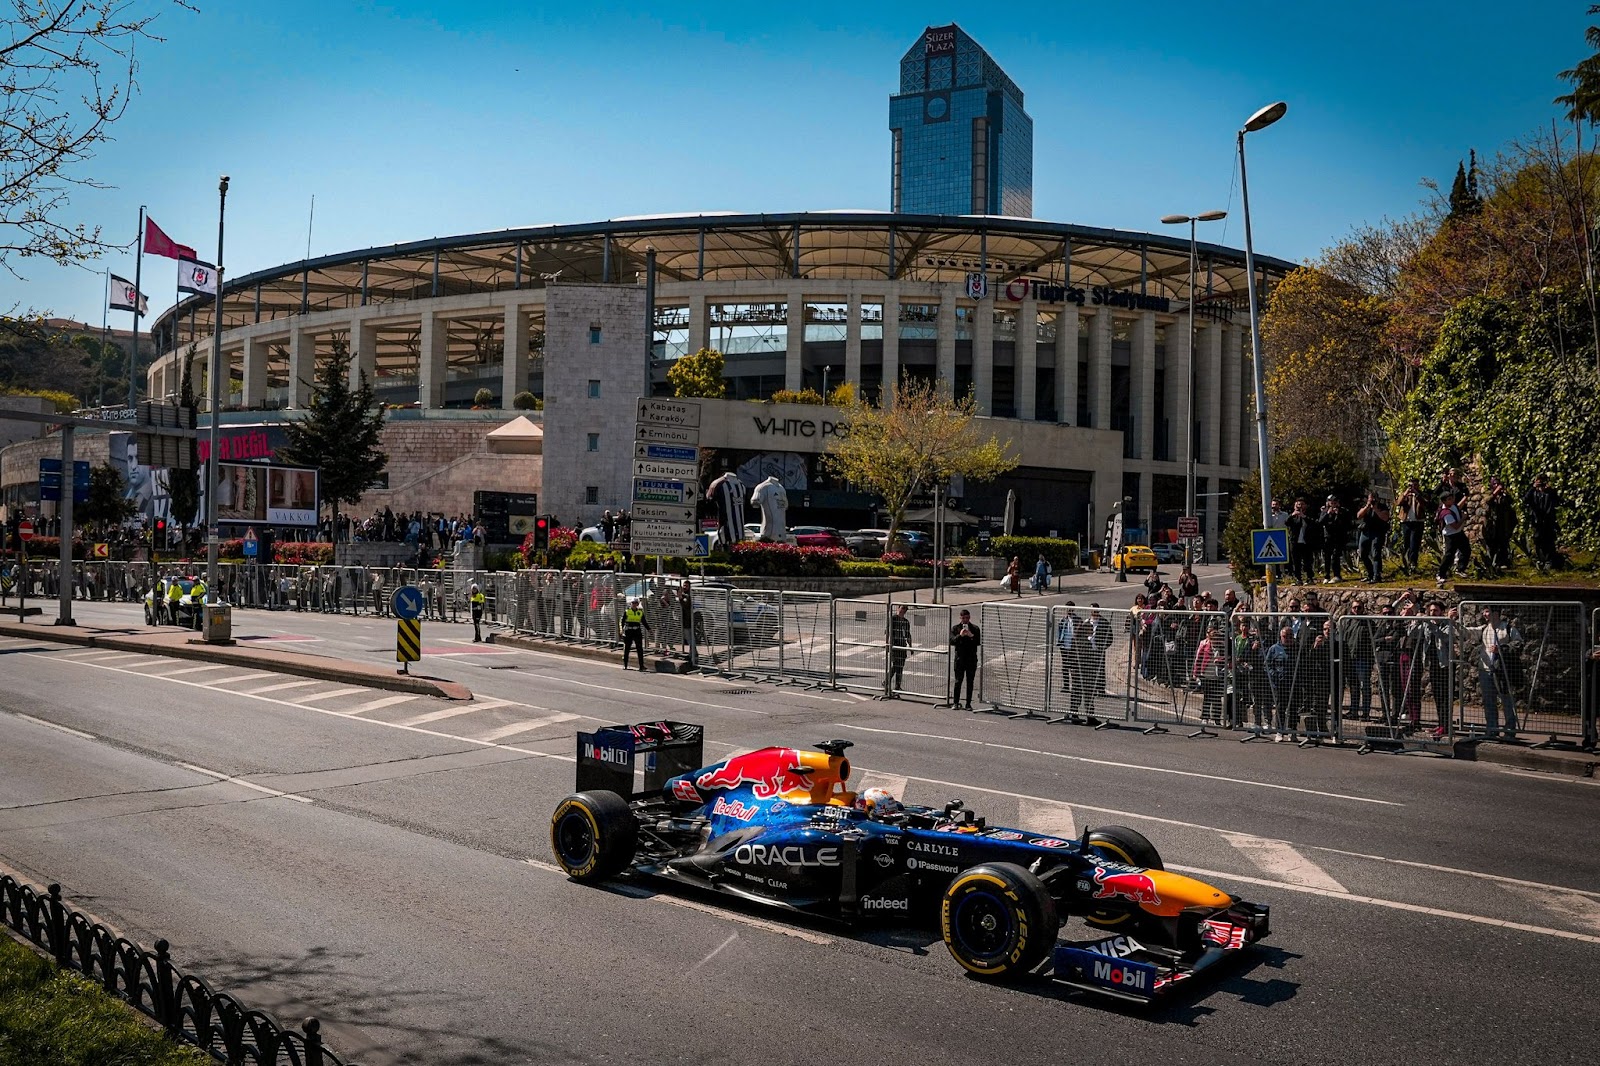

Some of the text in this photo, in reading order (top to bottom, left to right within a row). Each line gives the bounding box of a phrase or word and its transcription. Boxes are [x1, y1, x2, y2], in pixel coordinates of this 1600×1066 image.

[925, 32, 955, 43] SÜZER
[925, 42, 955, 53] PLAZA
[650, 402, 686, 413] Kabataş
[649, 413, 685, 424] Karaköy
[649, 429, 688, 440] Eminönü
[645, 464, 694, 476] Galataport
[274, 511, 311, 521] VAKKO
[637, 507, 667, 516] Taksim
[584, 743, 615, 763] Mobil
[734, 844, 841, 866] ORACLE
[906, 841, 960, 857] CARLYLE
[917, 860, 959, 874] 1Password
[861, 895, 909, 910] indeed
[942, 899, 952, 943] PIRELLI
[1010, 908, 1028, 964] ZERO
[1085, 935, 1148, 958] VISA
[1093, 960, 1146, 990] Mobil
